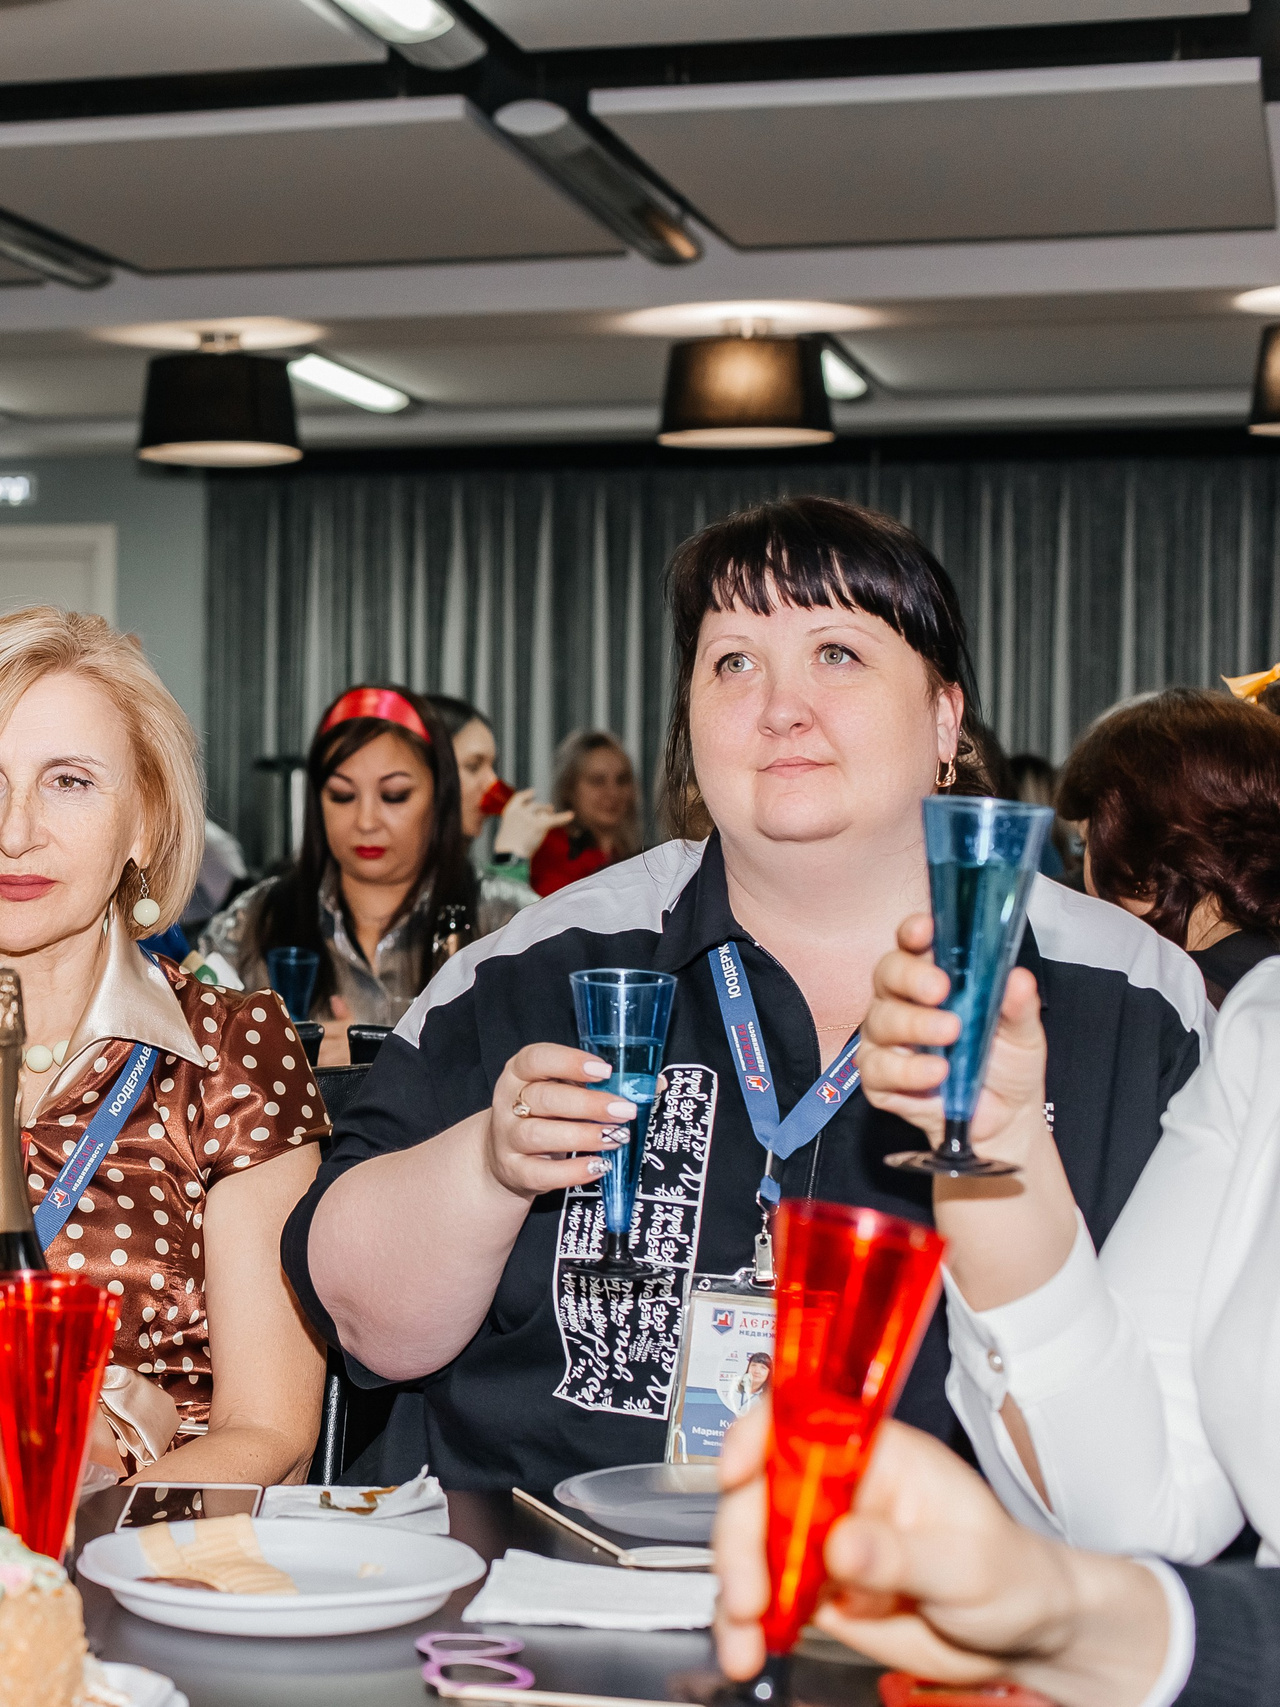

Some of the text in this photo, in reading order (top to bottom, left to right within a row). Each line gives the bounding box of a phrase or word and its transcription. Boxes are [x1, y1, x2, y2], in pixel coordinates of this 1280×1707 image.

[748, 1021, 766, 1073] НЕДВИЖИМОСТЬ
[108, 1045, 153, 1118] ЮОДЕРЖАВ
[663, 1119, 675, 1152] AWESOME
[64, 1138, 98, 1189] ДЕРЖАВА
[71, 1142, 104, 1193] НЕДВИЖИМОСТЬ
[691, 1425, 725, 1438] Мария
